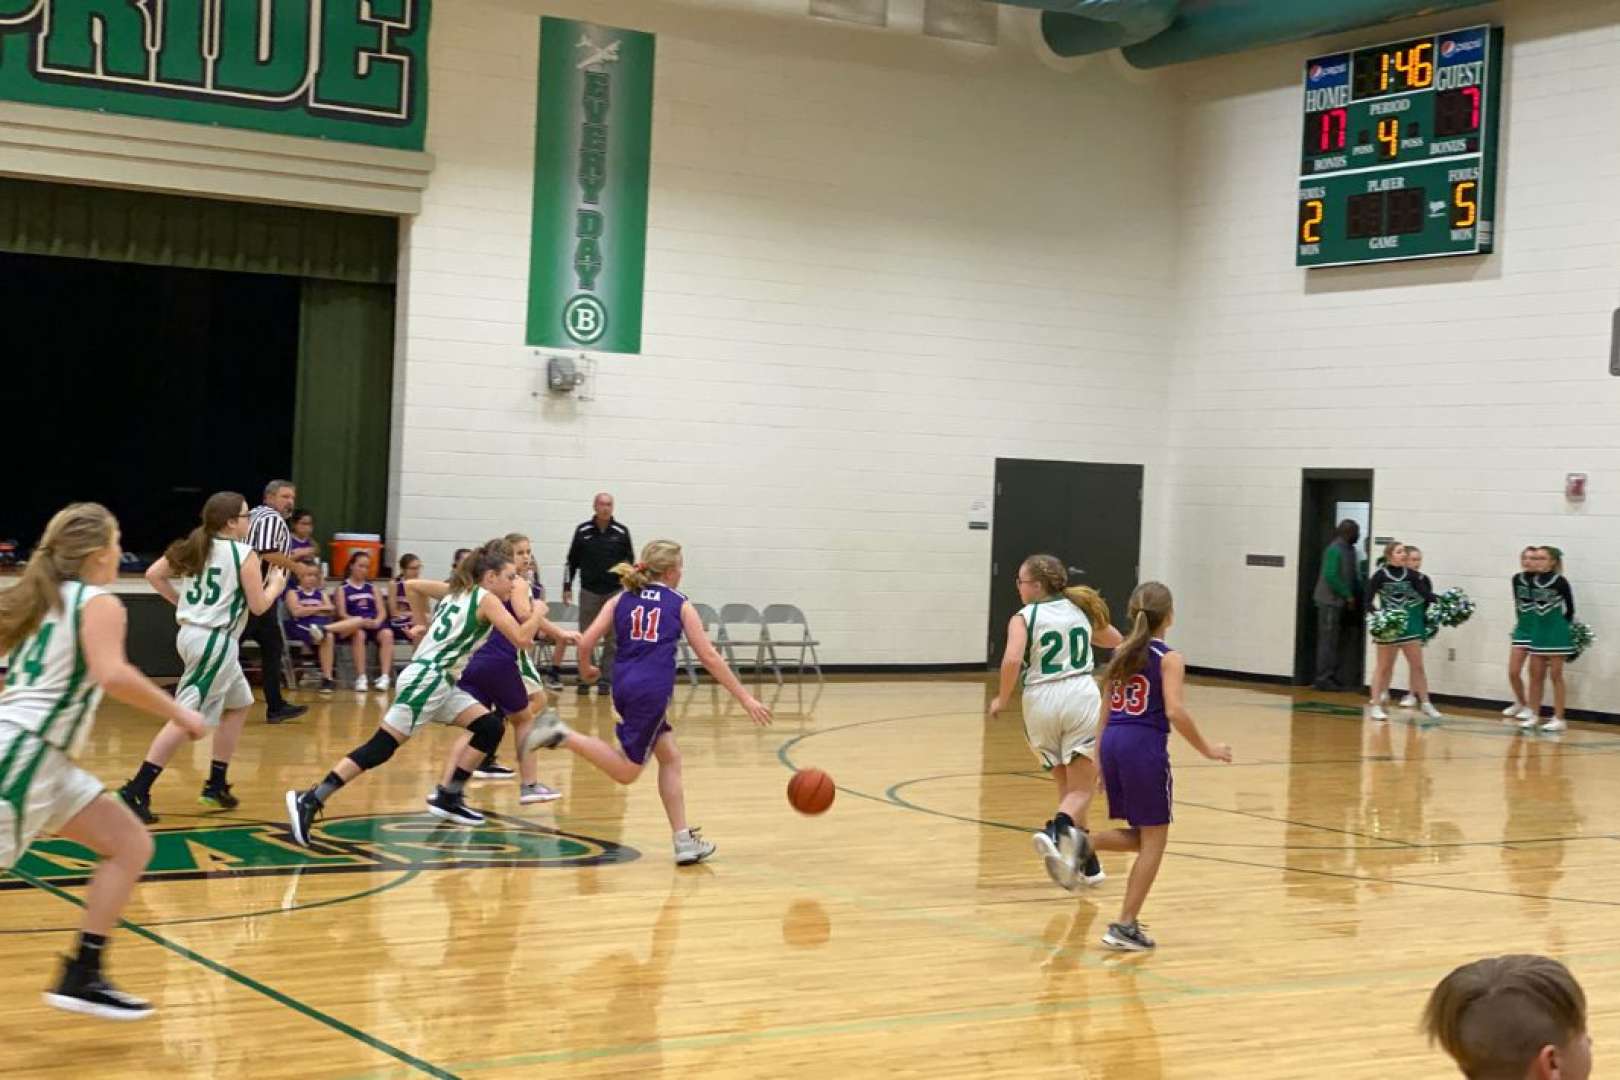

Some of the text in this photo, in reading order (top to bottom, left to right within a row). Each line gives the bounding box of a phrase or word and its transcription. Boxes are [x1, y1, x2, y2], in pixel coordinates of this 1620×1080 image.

[0, 0, 414, 123] RIDE
[1380, 42, 1433, 91] 1:46
[1437, 60, 1484, 91] GUEST
[1305, 84, 1350, 112] HOME
[1461, 84, 1481, 130] 7
[1319, 107, 1349, 152] 17
[1376, 117, 1399, 157] 4
[1302, 199, 1324, 243] 2
[1454, 180, 1475, 228] 5
[576, 308, 595, 331] B
[186, 566, 222, 606] 35
[630, 604, 661, 643] 11
[1040, 626, 1090, 675] 20
